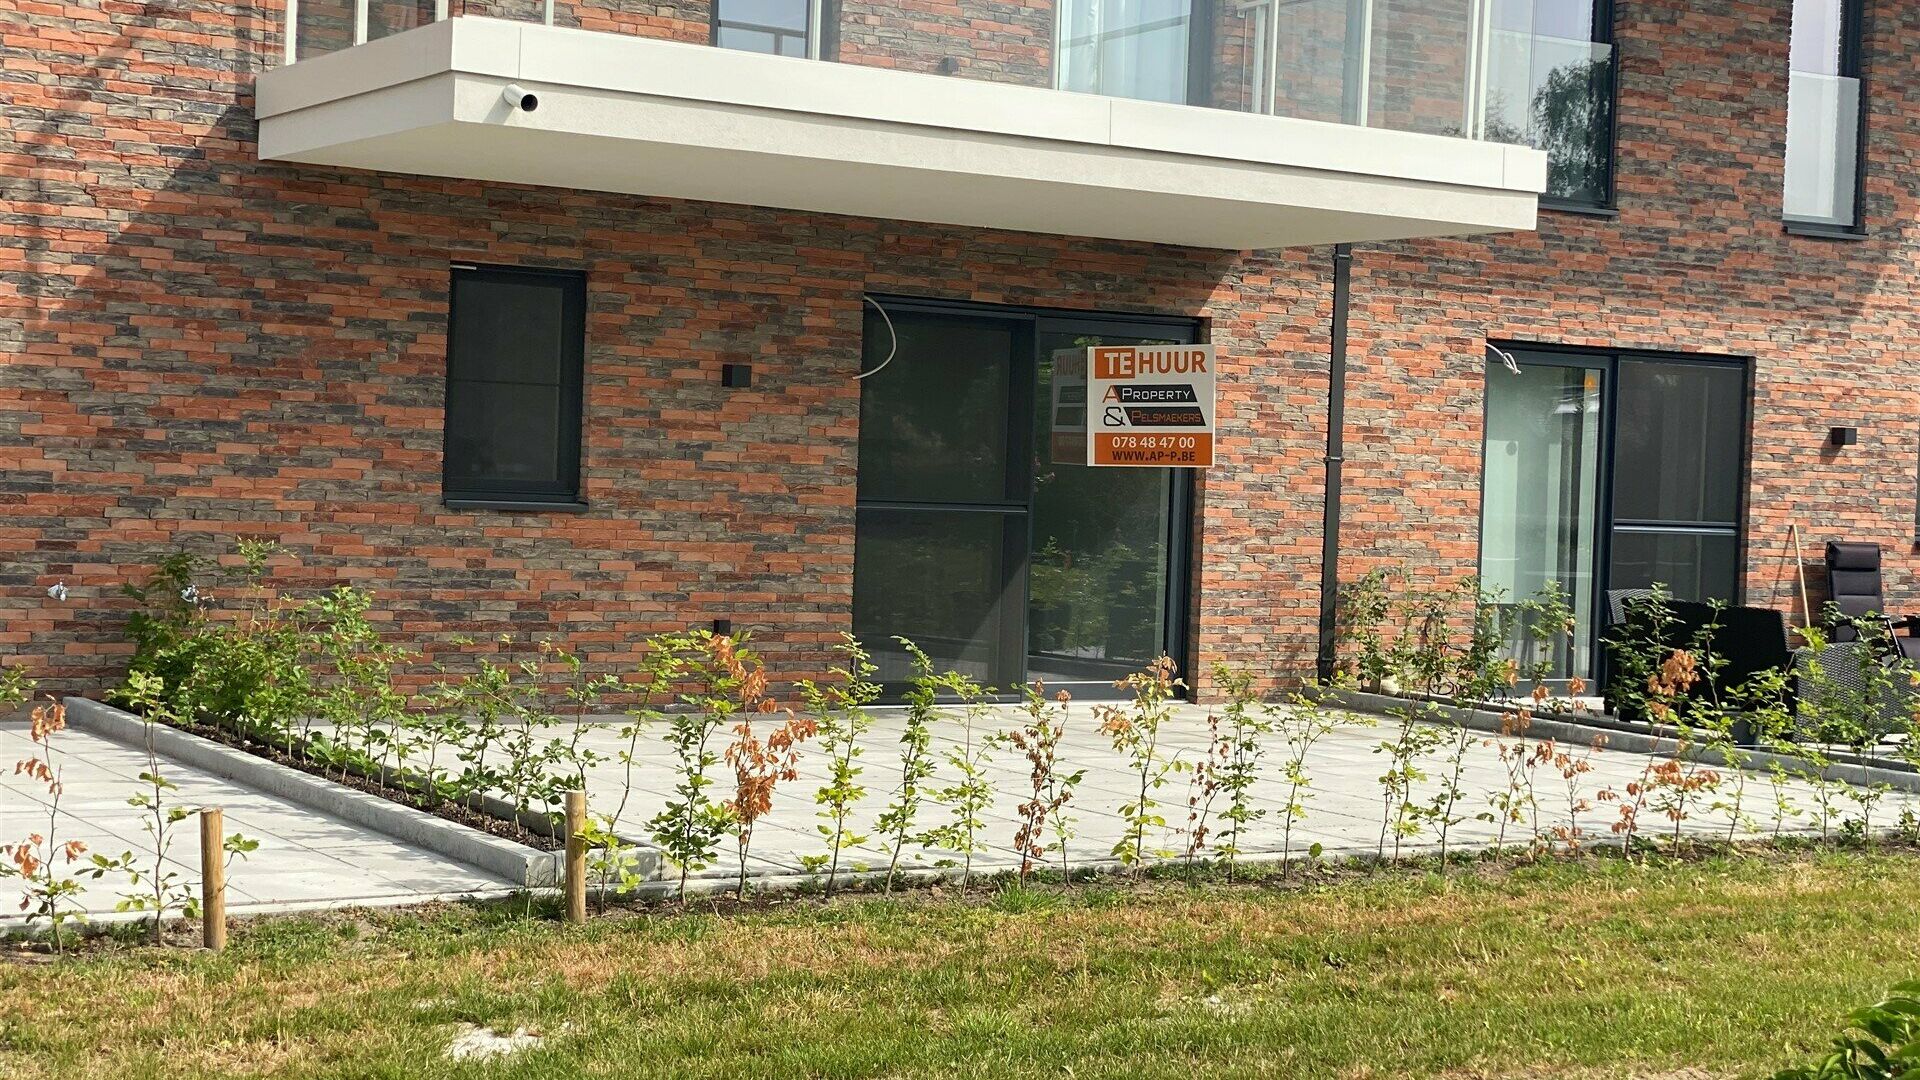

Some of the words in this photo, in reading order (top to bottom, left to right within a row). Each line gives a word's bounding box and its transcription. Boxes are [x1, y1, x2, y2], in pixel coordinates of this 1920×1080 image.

[1104, 352, 1132, 375] TE
[1139, 351, 1207, 374] HUUR
[1102, 385, 1121, 403] A
[1122, 388, 1191, 400] PROPERTY
[1103, 406, 1126, 426] &
[1131, 411, 1201, 423] PELSMAEKERS
[1112, 437, 1136, 448] 078
[1140, 437, 1156, 448] 48
[1159, 437, 1174, 448] 47
[1178, 437, 1195, 448] 00
[1112, 451, 1195, 462] WWW.AP-P.BE
